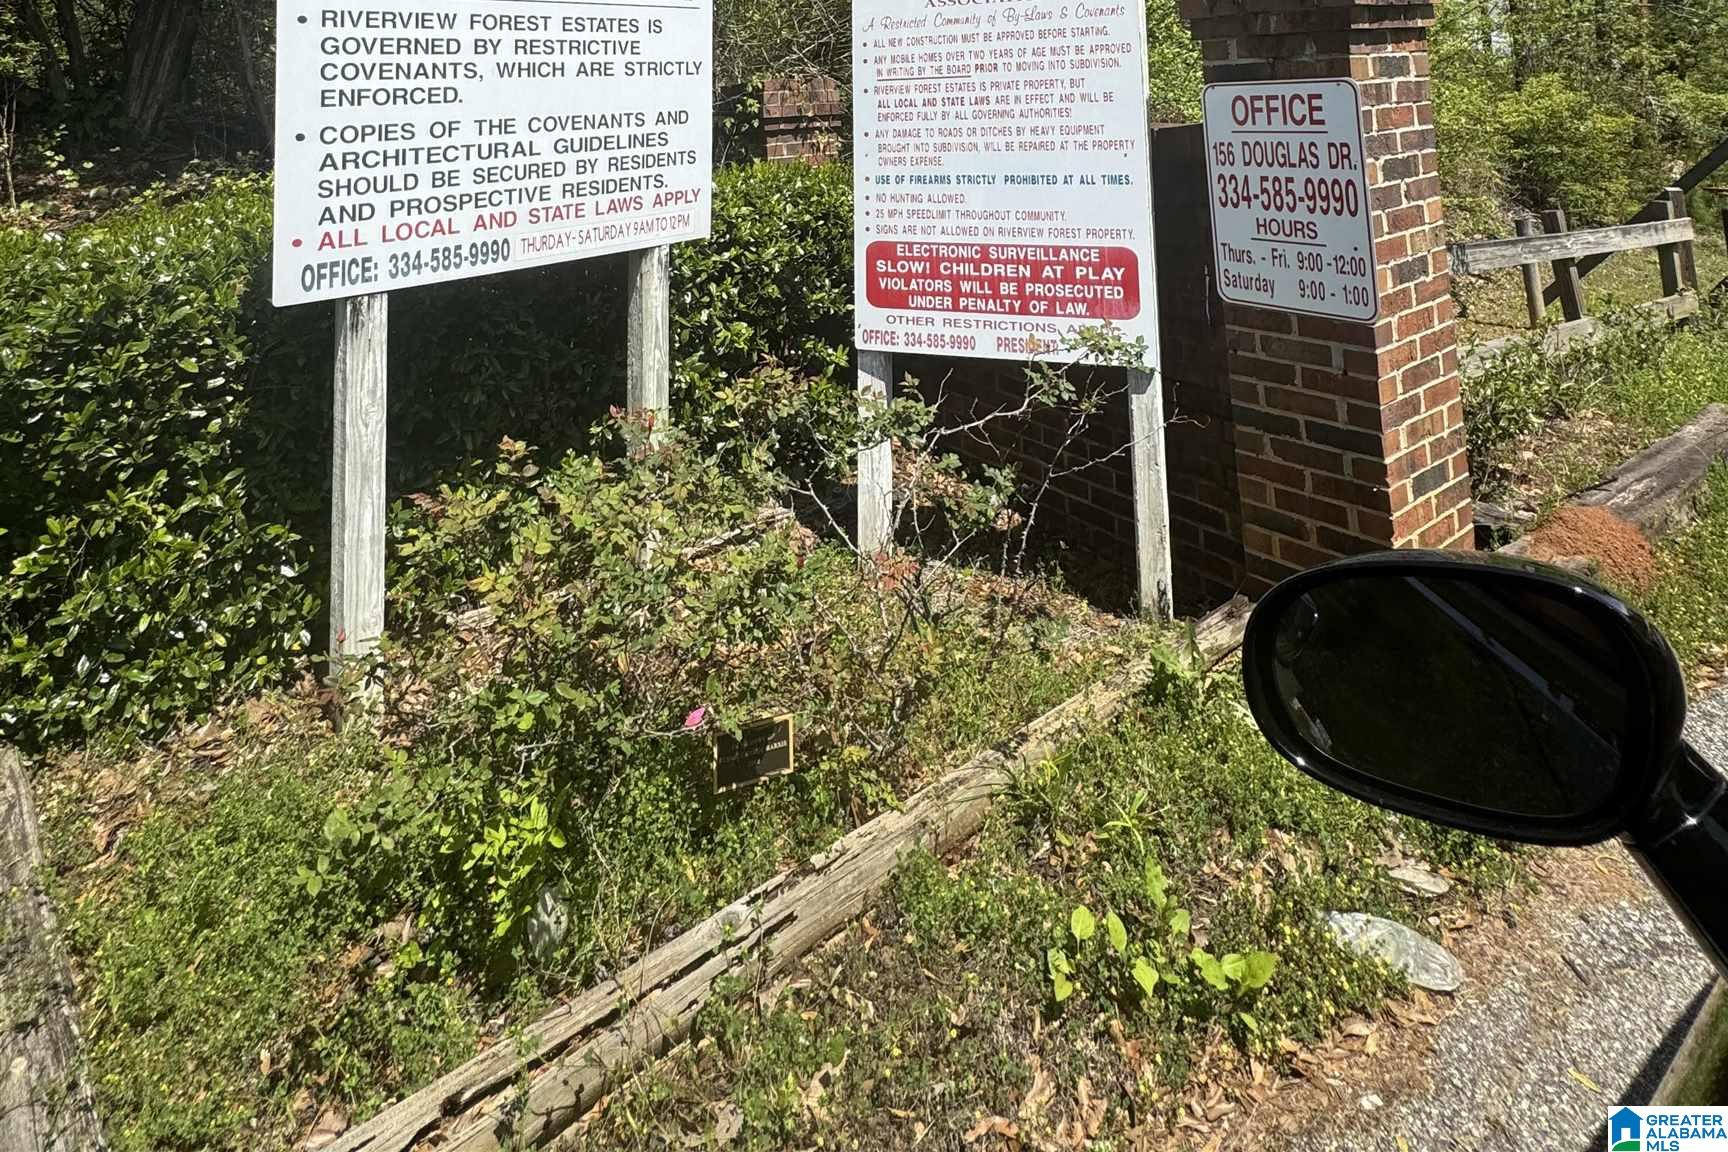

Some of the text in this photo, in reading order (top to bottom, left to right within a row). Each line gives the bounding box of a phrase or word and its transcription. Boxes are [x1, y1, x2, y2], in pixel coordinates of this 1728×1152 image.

[322, 10, 662, 34] RIVERVIEW FOREST ESTATES IS
[862, 2, 1125, 32] A Restricted Community of By-Laws & Covenants
[321, 37, 640, 55] GOVERNED BY RESTRICTIVE
[320, 61, 702, 82] COVENANTS, WHICH ARE STRICTLY
[321, 87, 463, 107] ENFORCED.
[878, 92, 1114, 109] ALL LOCAL AND STATE LAWS ARE IN EFFECT AND WILL BE
[878, 112, 913, 122] ENFORCED
[917, 111, 937, 121] FULLY
[941, 111, 950, 120] BY
[955, 110, 968, 120] ALL
[972, 109, 1015, 120] GOVERNING
[1232, 93, 1326, 126] OFFICE
[320, 110, 688, 145] COPIES OF THE COVENANTS AND
[875, 124, 1104, 138] ANY DAMAGE TO ROADS OR DITCHES BY HEAVY EQUIPMENT
[319, 132, 668, 172] ARCHITECTURAL GUIDELINES
[1213, 141, 1357, 170] 156 DOUGLAS DR.
[318, 150, 696, 198] SHOULD BE SECURED BY RESIDENTS
[875, 174, 1133, 185] USE OF FIREARMS STRICTLY PROHIBITED AT ALL TIMES.
[318, 174, 668, 226] AND PROSPECTIVE RESIDENTS.
[876, 193, 887, 203] NO
[890, 193, 923, 203] HUNTING
[1218, 173, 1358, 217] 334-585-9990
[318, 188, 701, 251] ALL LOCAL AND STATE LAWS APPLY
[876, 209, 884, 218] 25
[888, 209, 903, 218] MPH
[907, 209, 951, 219] SPEEDLIMIT
[955, 210, 1011, 220] THROUGHOUT
[876, 224, 1135, 240] SIGNS ARE NOT ALLOWED ON RIVERVIEW FOREST PROPERTY.
[1256, 217, 1318, 240] HOURS
[897, 244, 1100, 261] ELECTRONIC SURVEILLANCE
[1220, 242, 1255, 264] Thurs.
[1271, 248, 1290, 268] Fri.
[1297, 251, 1323, 272] 9:00
[301, 238, 510, 292] OFFICE: 334-585-9990
[876, 260, 1125, 280] SLOW! CHILDREN AT PLAY
[879, 278, 1123, 299] VIOLATORS WILL BE PROSECUTED
[1224, 268, 1274, 299] Saturday
[1299, 279, 1325, 301] 9:00
[1342, 284, 1369, 307] 1:00
[909, 295, 1089, 316] UNDER PENALTY OF LAW.
[886, 315, 935, 326] OTHER
[943, 318, 1056, 333] RESTRICTIONS
[862, 329, 899, 346] OFFICE:
[904, 332, 976, 351] 334-585-9990
